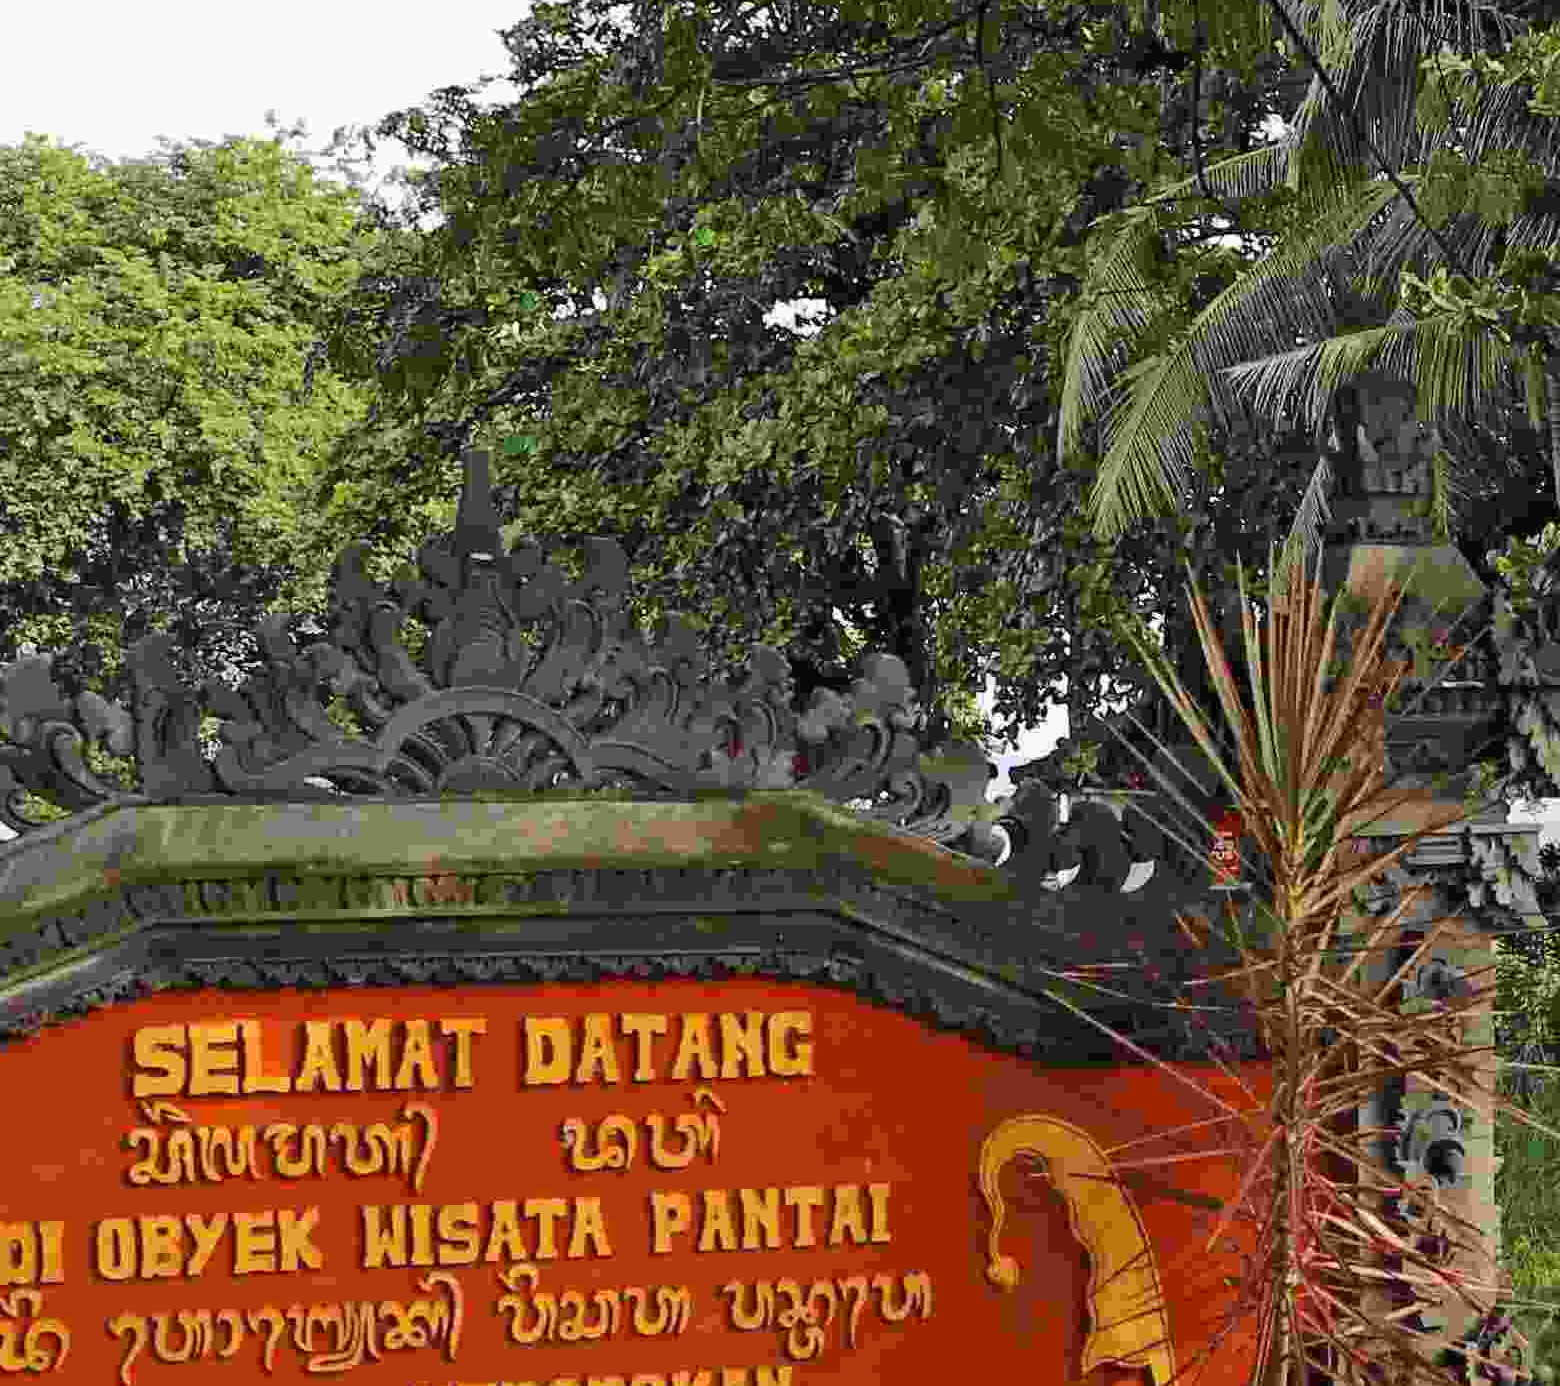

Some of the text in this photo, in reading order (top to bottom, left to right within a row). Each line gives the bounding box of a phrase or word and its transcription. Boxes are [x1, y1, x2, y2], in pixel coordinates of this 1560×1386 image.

[133, 1012, 812, 1097] SELAMAT DATANG
[95, 1207, 323, 1281] OBYEK
[361, 1196, 613, 1270] WISATA
[649, 1182, 892, 1255] PANTAI
